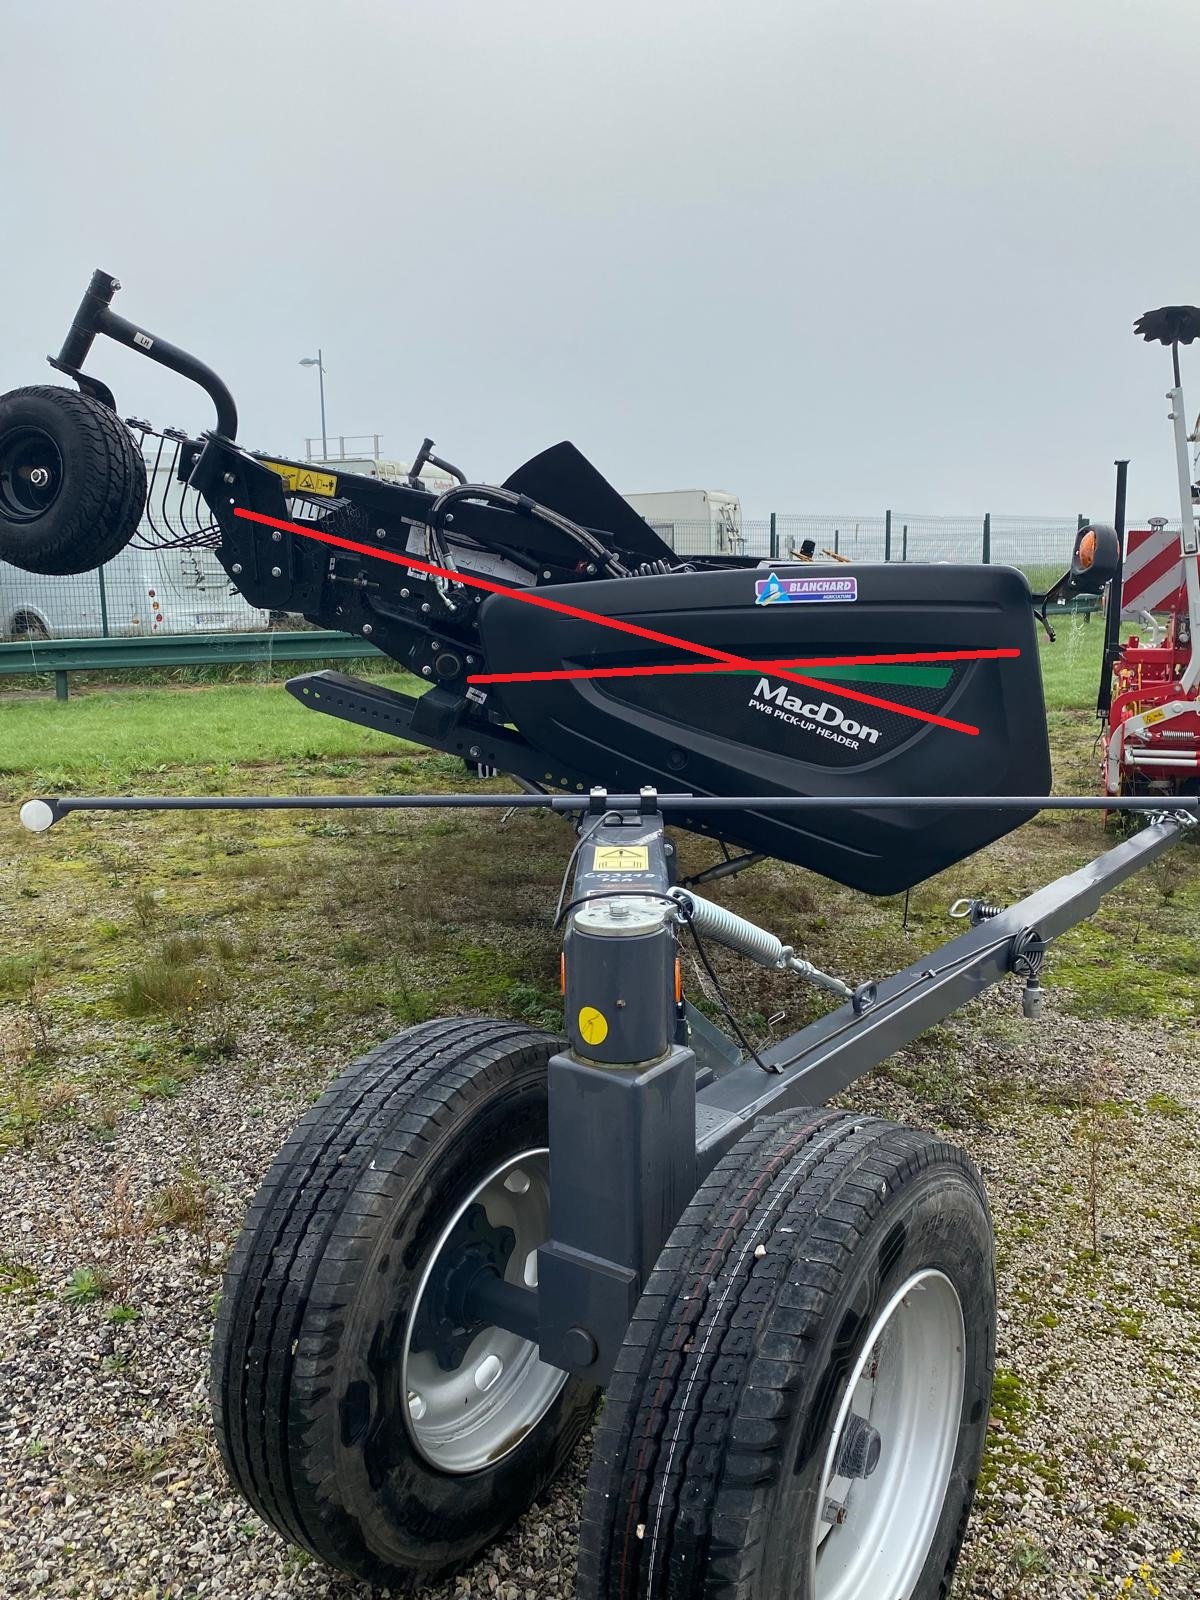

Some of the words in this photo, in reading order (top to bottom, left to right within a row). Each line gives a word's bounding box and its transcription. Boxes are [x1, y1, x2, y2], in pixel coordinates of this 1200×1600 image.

[789, 581, 851, 592] BLANCHARD
[748, 699, 772, 715] PW8
[773, 709, 816, 732] PICK-UP
[816, 726, 860, 751] HEADER
[753, 677, 880, 744] MacDon
